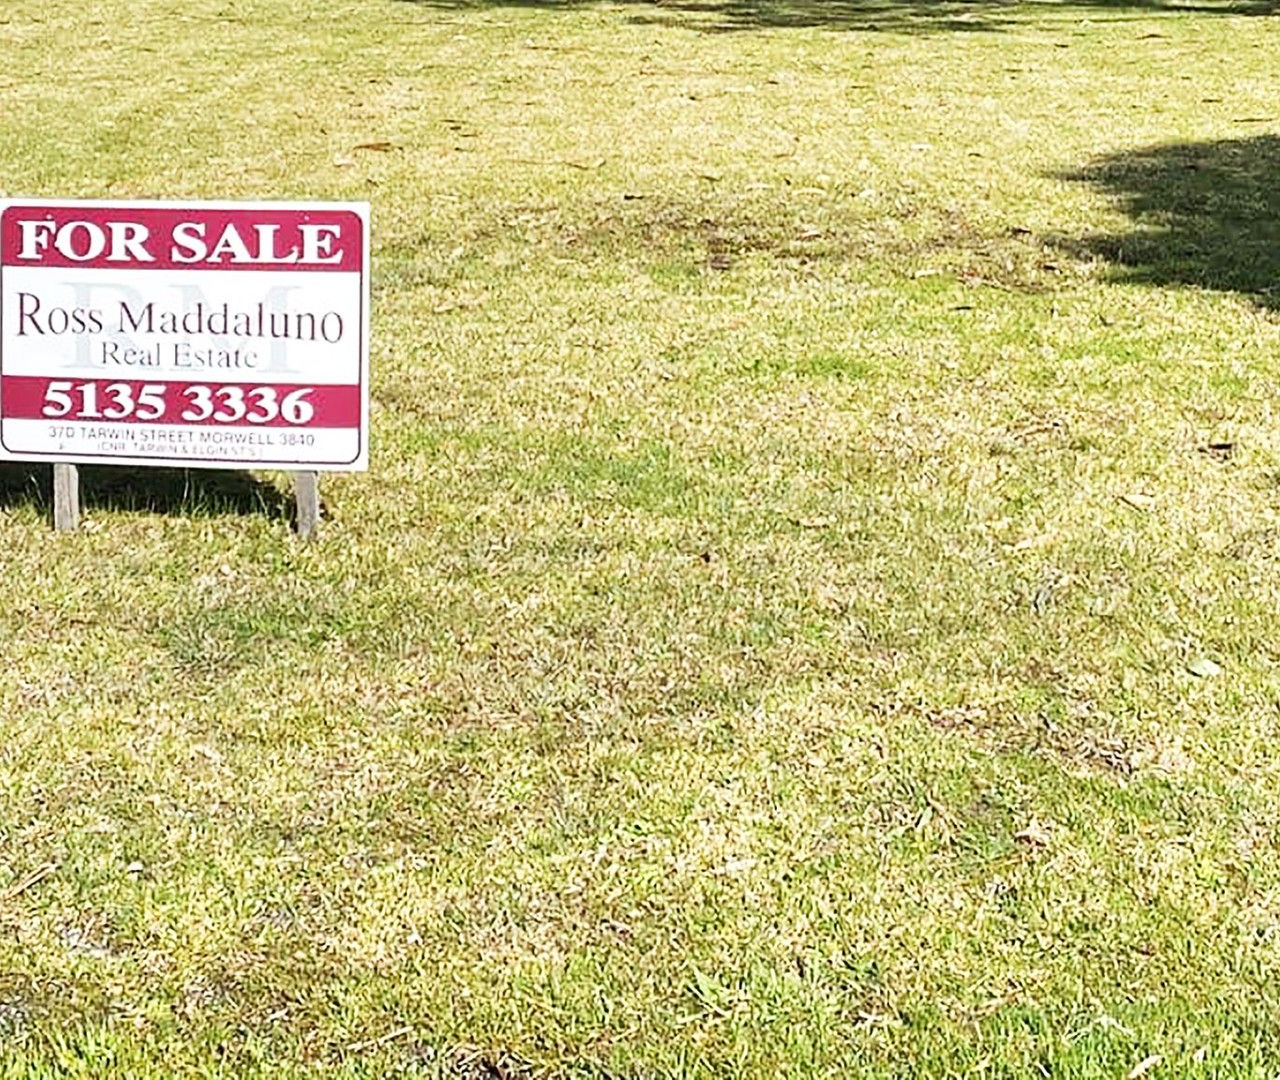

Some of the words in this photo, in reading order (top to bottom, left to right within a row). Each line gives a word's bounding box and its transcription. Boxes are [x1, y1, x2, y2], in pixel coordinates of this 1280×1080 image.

[17, 220, 155, 261] FOR
[171, 221, 344, 265] SALE
[15, 291, 104, 337] Ross
[118, 301, 344, 344] Maddaluno
[101, 341, 161, 367] Real
[173, 343, 259, 369] Estate
[42, 381, 167, 420] 5135
[182, 384, 315, 425] 3336
[80, 427, 135, 441] TARWIN
[139, 429, 194, 443] STREET
[200, 431, 275, 446] MORWELL
[279, 432, 315, 447] 3840
